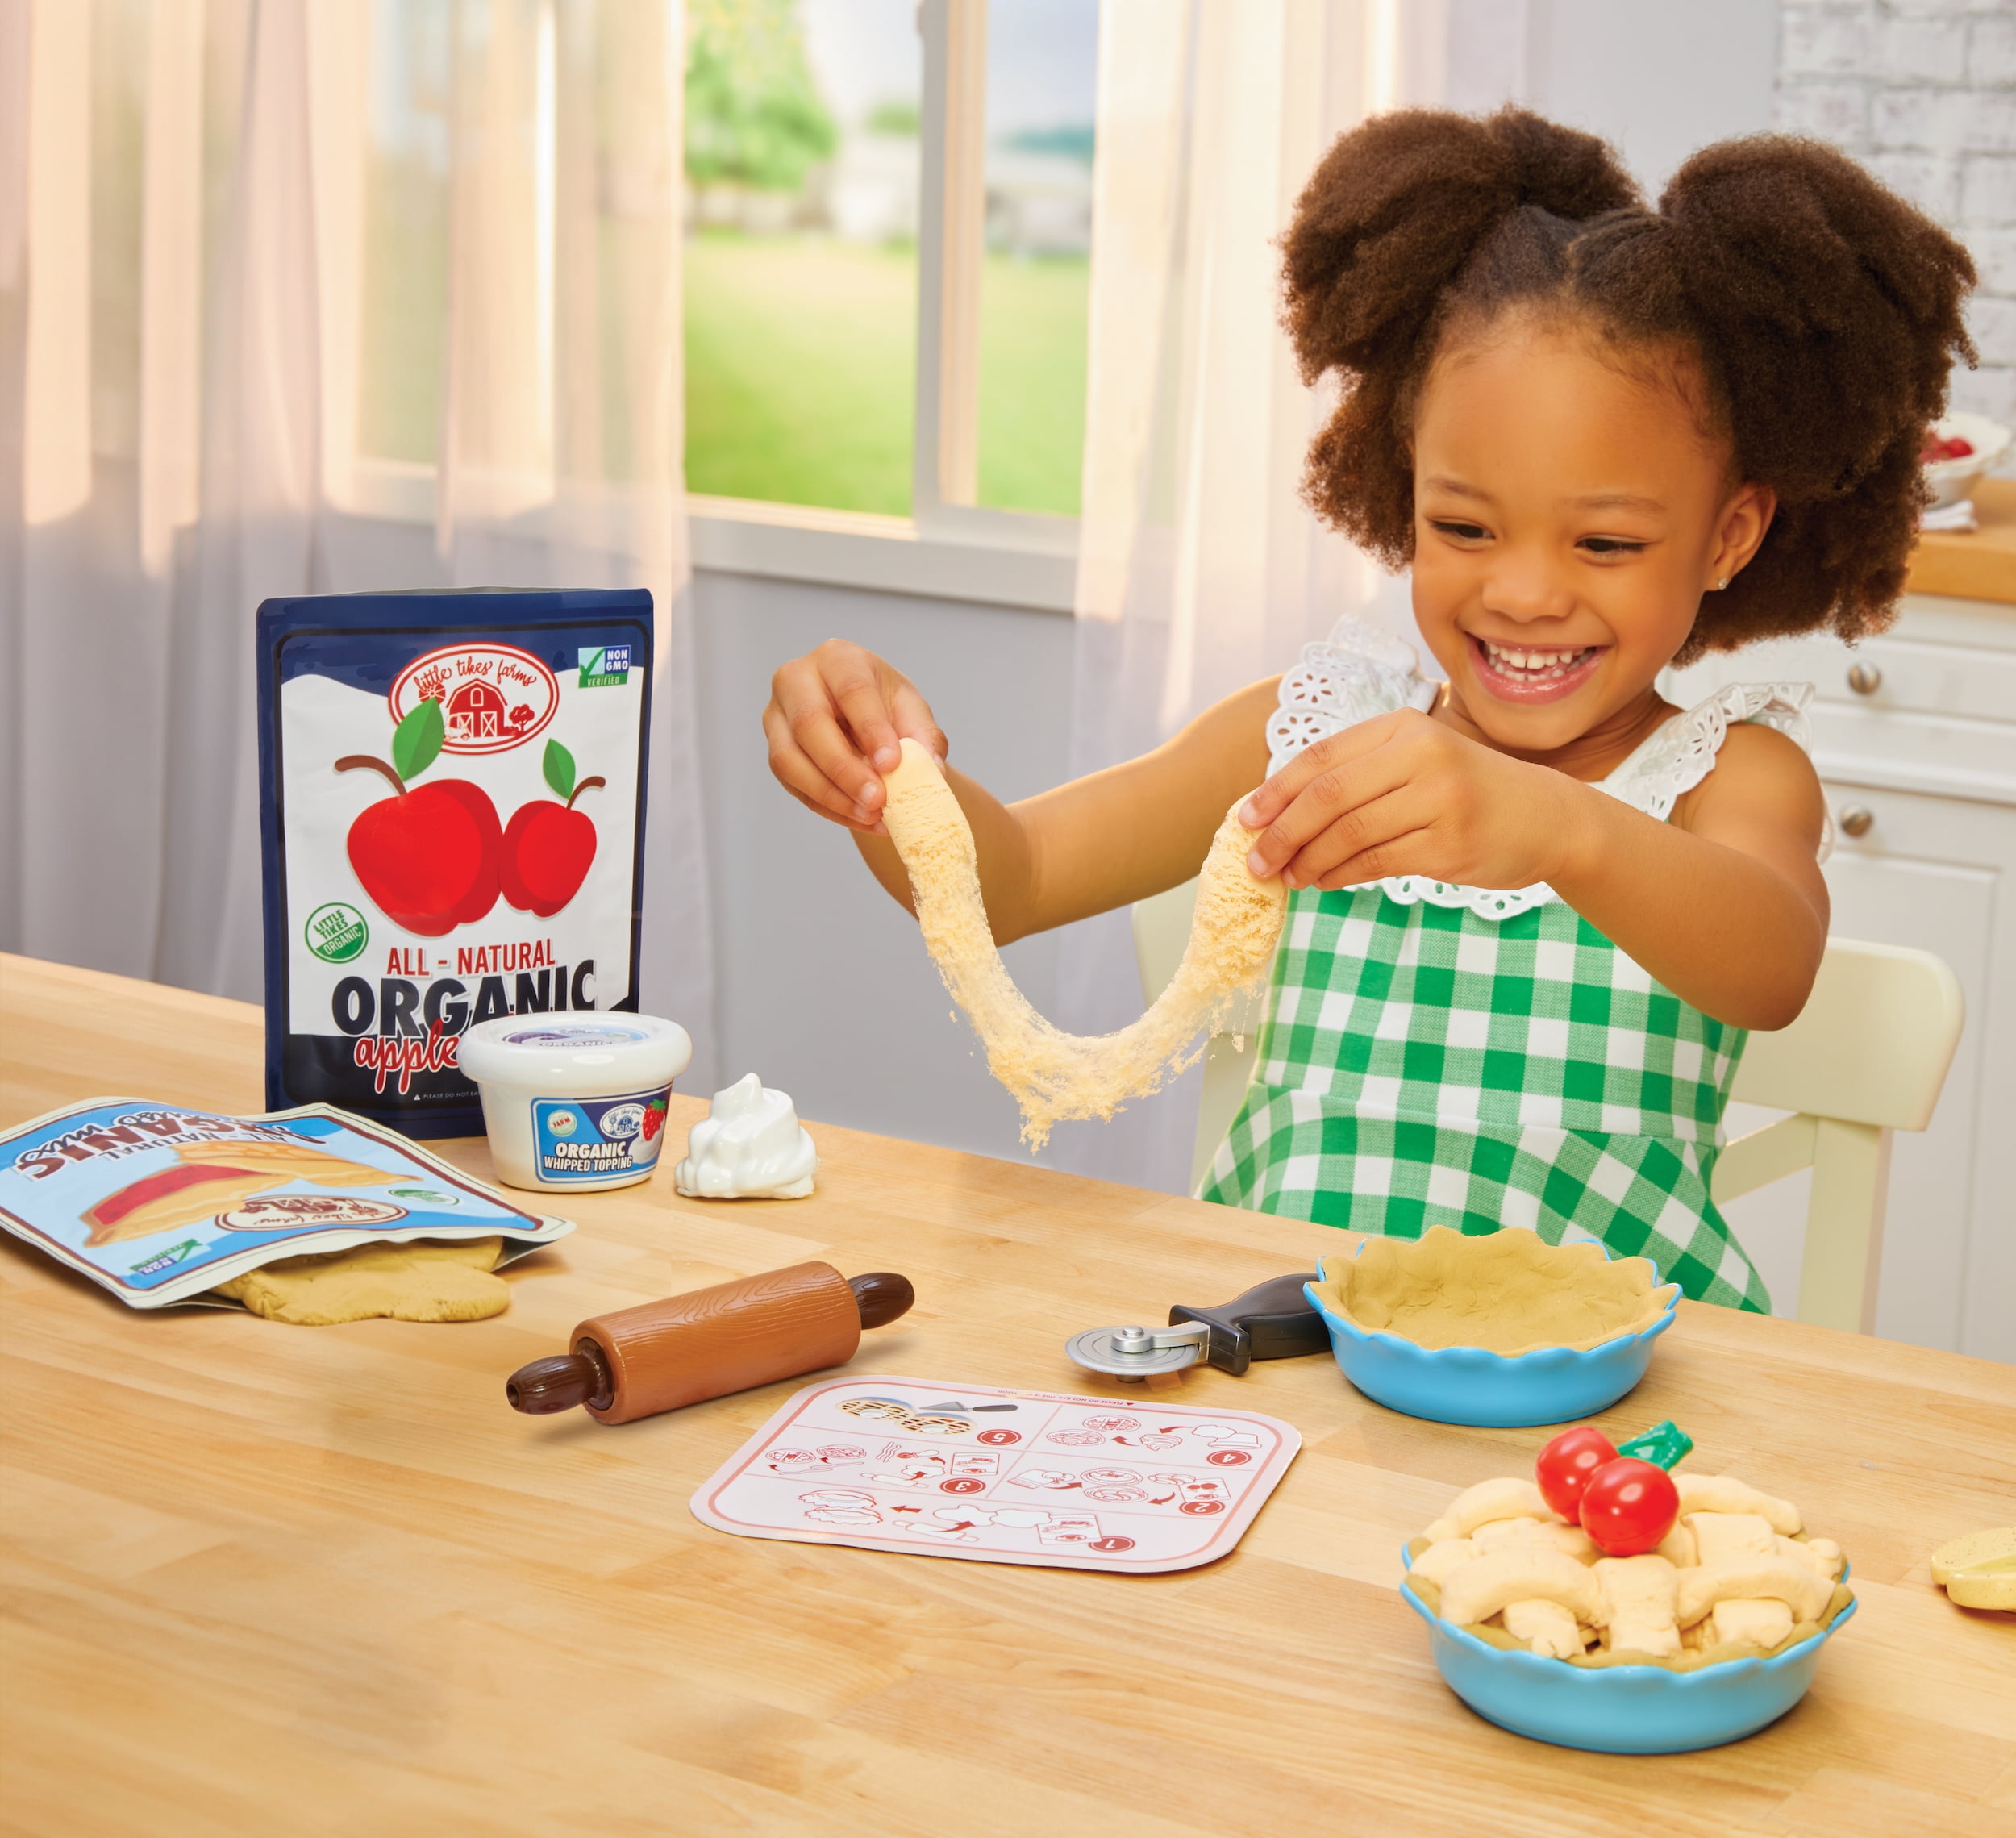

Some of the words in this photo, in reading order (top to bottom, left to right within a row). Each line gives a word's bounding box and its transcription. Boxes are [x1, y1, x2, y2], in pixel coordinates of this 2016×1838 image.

[607, 649, 627, 661] NON
[606, 660, 628, 671] GMO
[414, 665, 452, 692] little
[456, 656, 493, 676] tikes
[497, 659, 537, 686] farms
[587, 676, 620, 686] VERIFIED
[313, 910, 344, 934] LITTLE
[320, 919, 348, 940] TIKES
[323, 926, 361, 955] ORGANIC
[386, 948, 429, 976] ALL
[457, 938, 556, 975] NATURAL
[332, 959, 595, 1036] ORGANIC
[356, 1019, 459, 1094] apple
[98, 1132, 222, 1160] NATURAL
[556, 1141, 626, 1158] ORGANIC
[544, 1156, 590, 1171] WHIPPED
[594, 1155, 632, 1171] TOPPING
[991, 1433, 1006, 1442] 5
[1222, 1453, 1237, 1463] 4
[955, 1482, 971, 1491] 3
[1194, 1502, 1210, 1512] 2
[1105, 1540, 1116, 1549] 1
